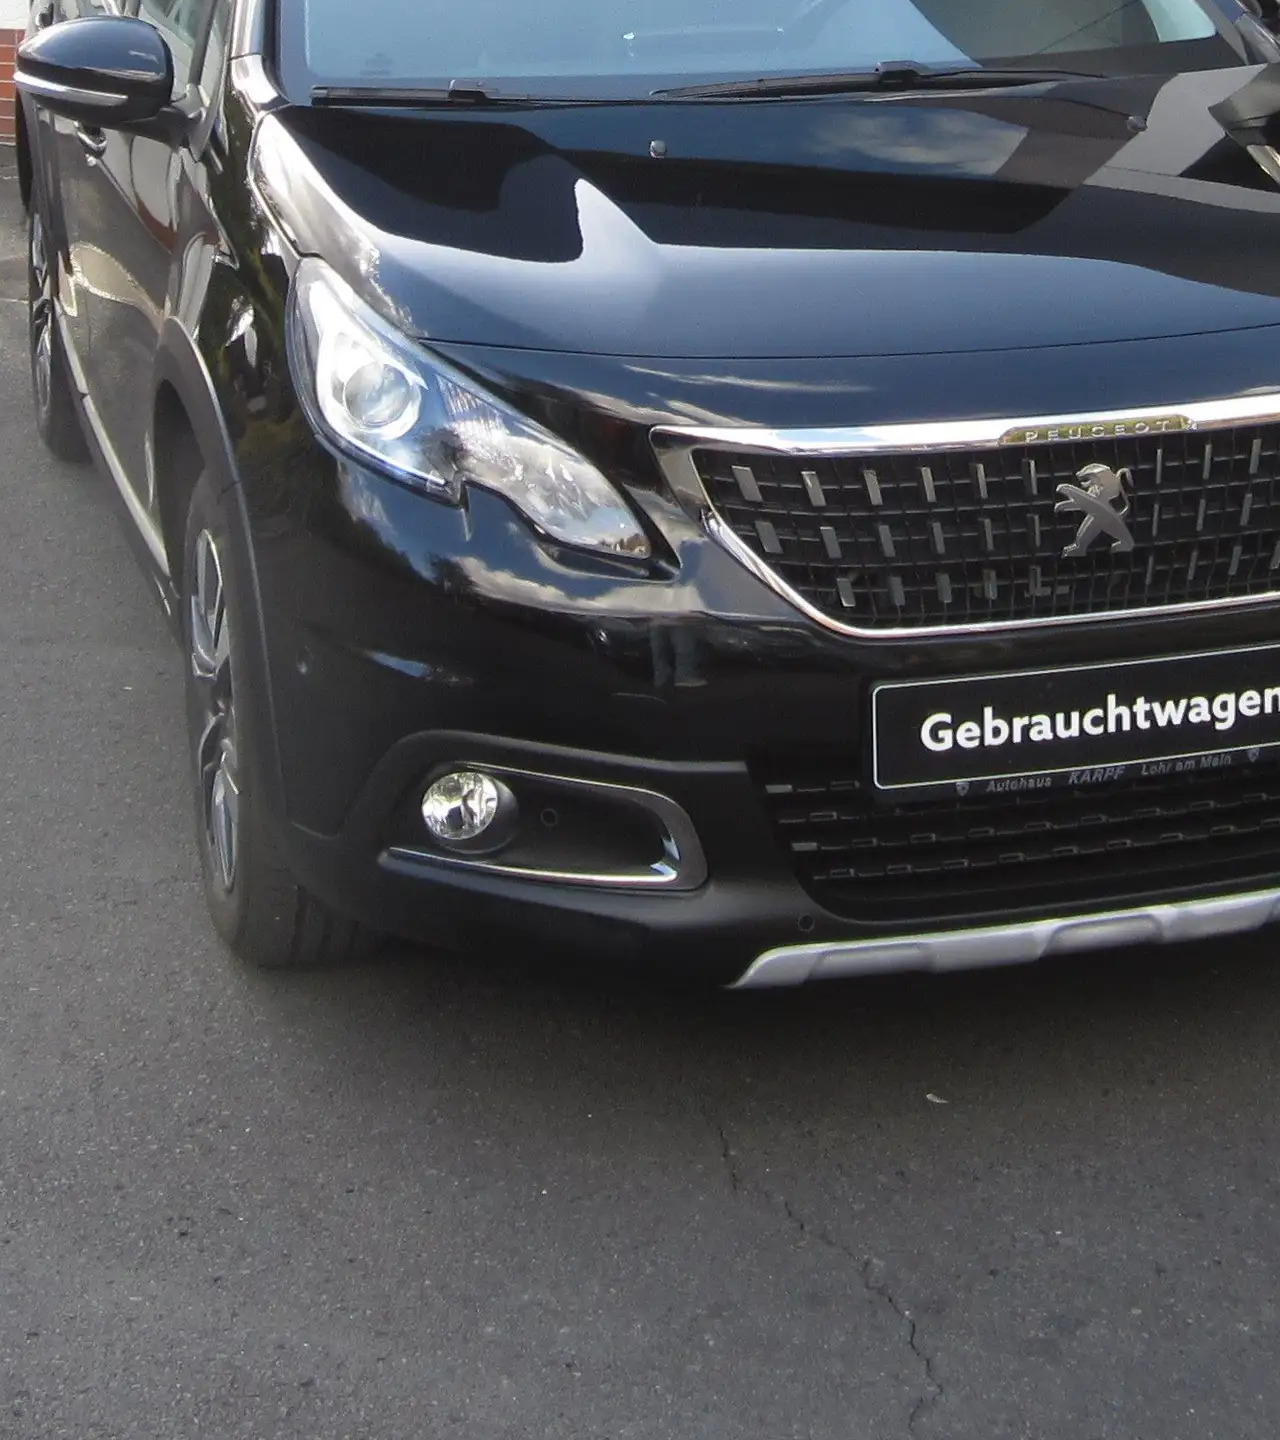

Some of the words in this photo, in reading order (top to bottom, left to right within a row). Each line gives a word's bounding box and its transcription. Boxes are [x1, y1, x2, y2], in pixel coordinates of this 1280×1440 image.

[1024, 419, 1171, 443] PEUGEOT
[986, 776, 1052, 793] Autohaus
[1068, 766, 1126, 785] KARPF
[1140, 762, 1172, 776] Lohr
[1175, 760, 1196, 771] am
[1199, 755, 1232, 769] Main
